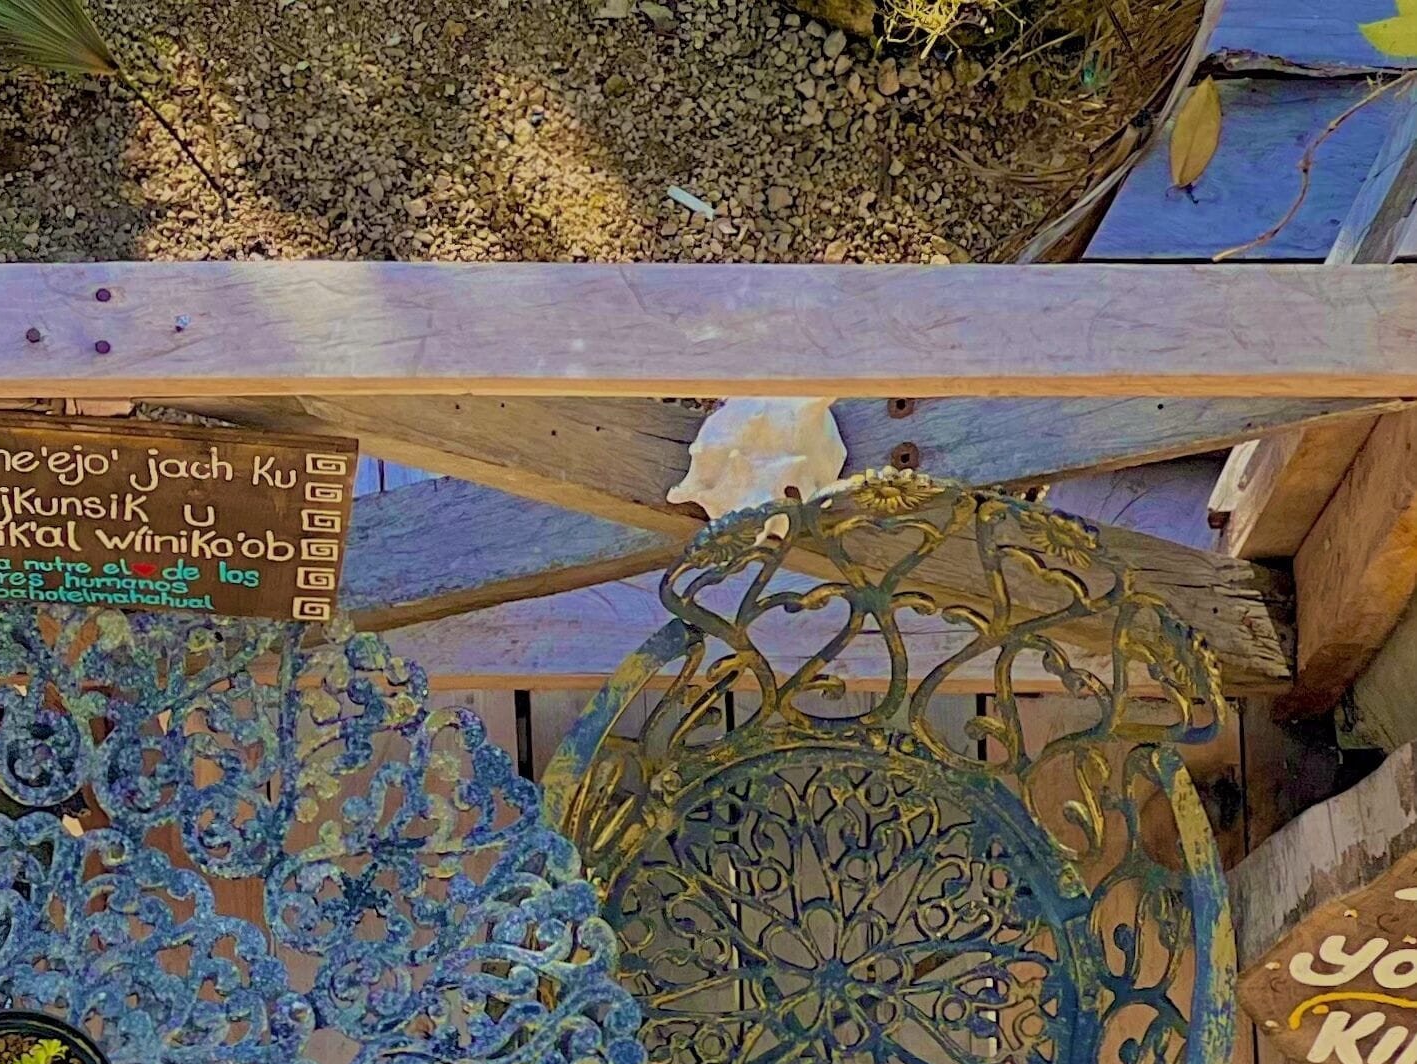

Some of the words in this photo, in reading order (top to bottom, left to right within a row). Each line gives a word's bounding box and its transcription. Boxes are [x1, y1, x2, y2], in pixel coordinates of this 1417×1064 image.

[130, 446, 233, 492] jach
[23, 555, 92, 574] nutre
[102, 558, 133, 575] el
[161, 558, 201, 580] de
[219, 560, 260, 587] los
[64, 571, 189, 594] humanos
